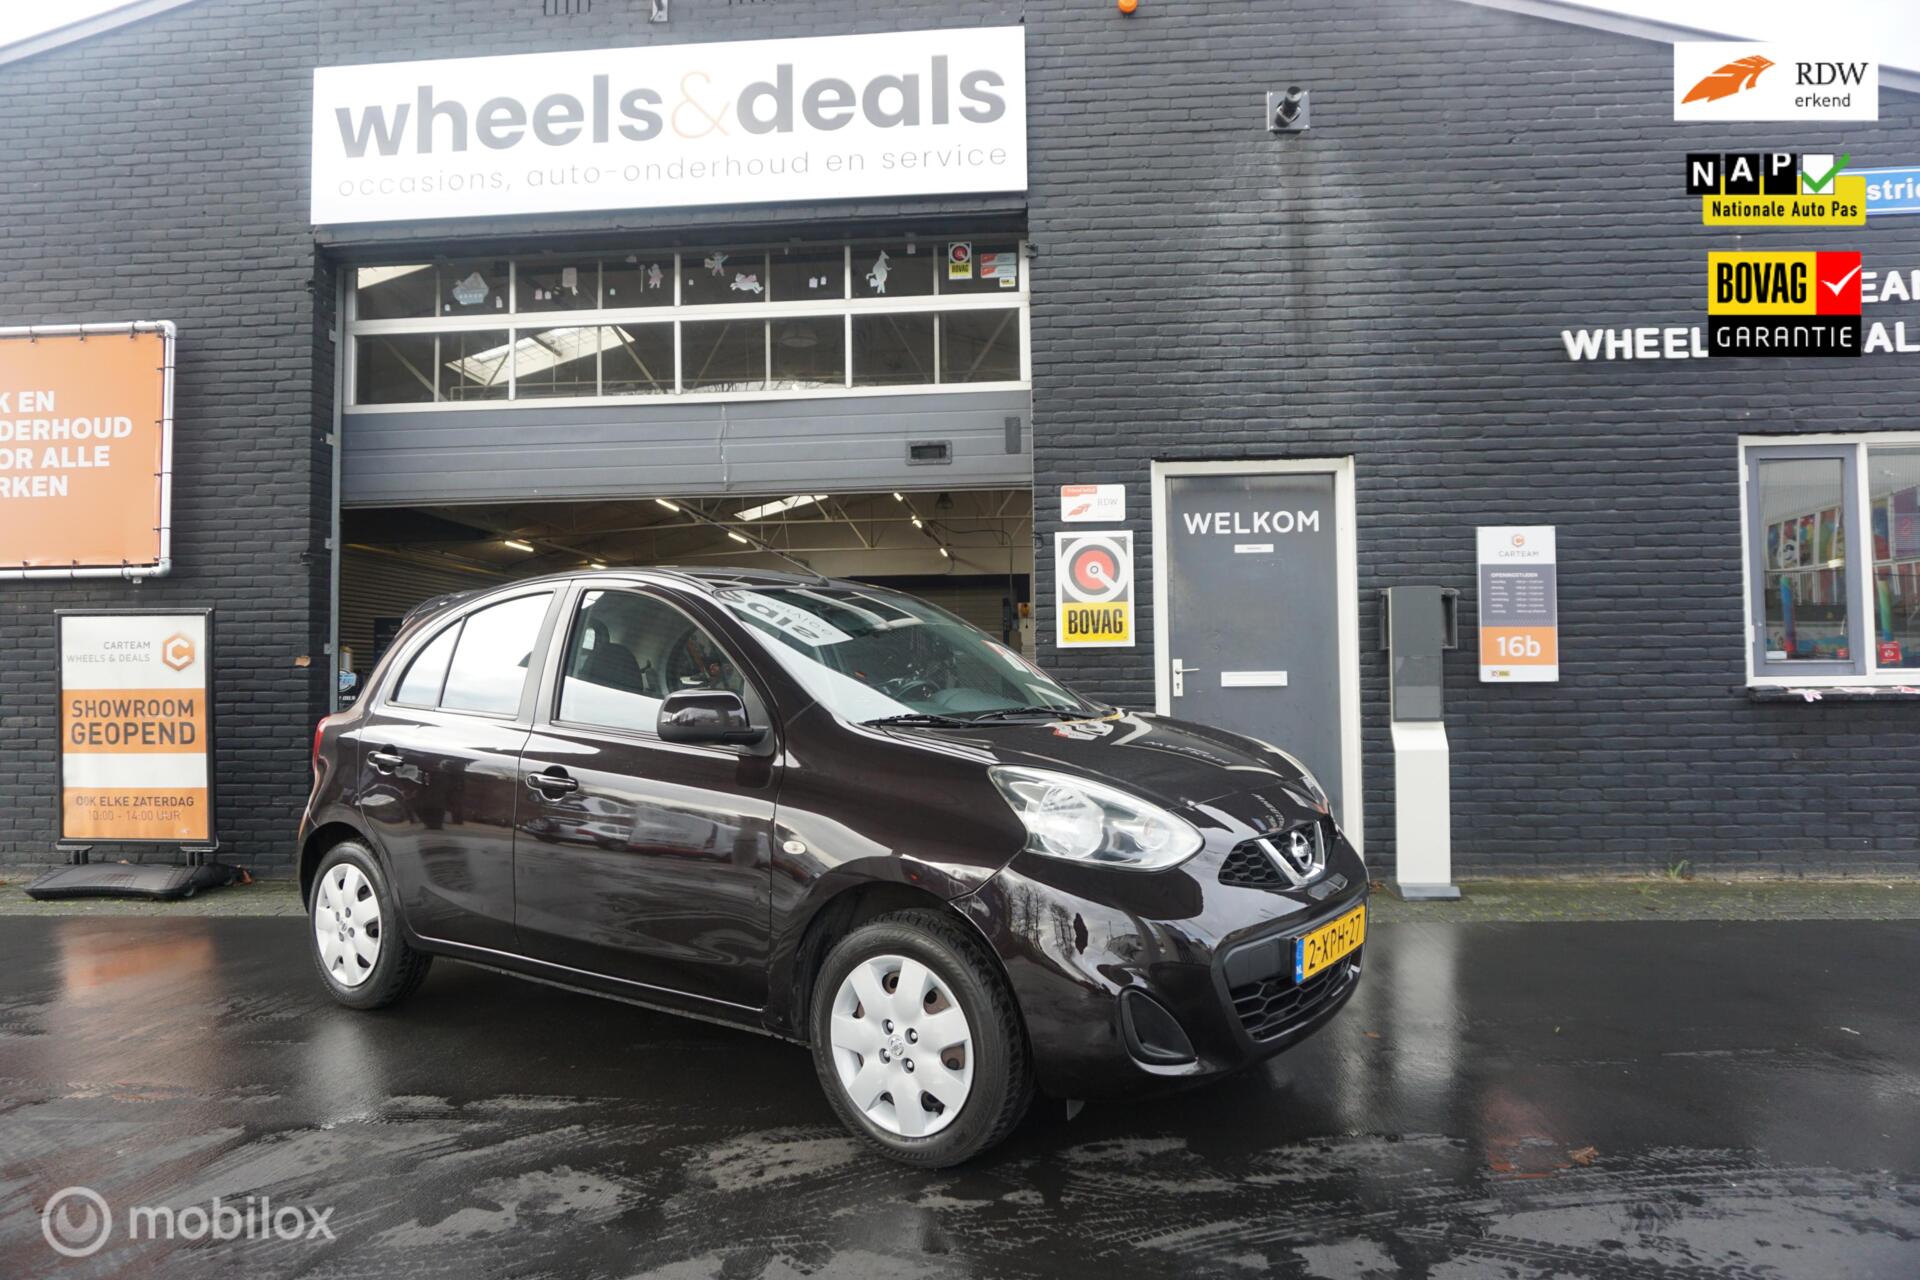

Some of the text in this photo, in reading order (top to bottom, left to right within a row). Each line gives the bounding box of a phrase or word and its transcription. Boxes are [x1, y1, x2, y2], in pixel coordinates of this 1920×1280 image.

[338, 144, 1007, 197] occasions, auto-onderhoud en service
[18, 390, 55, 413] EN
[41, 445, 110, 469] ALLE
[1183, 510, 1319, 535] WELKOM
[1498, 550, 1540, 558] CARTEAM
[1067, 609, 1123, 635] BOVAG
[103, 641, 151, 650] CARTEAM
[1496, 635, 1541, 657] 16b
[65, 653, 151, 663] WHEELS & DEALS
[72, 699, 194, 718] SHOWROOM
[71, 721, 196, 745] GEOPEND
[100, 796, 130, 807] ELKE
[133, 795, 195, 807] ZATERDAG
[127, 810, 154, 821] 14:00
[156, 810, 182, 821] UUR
[1308, 913, 1362, 970] 2-XPH-27
